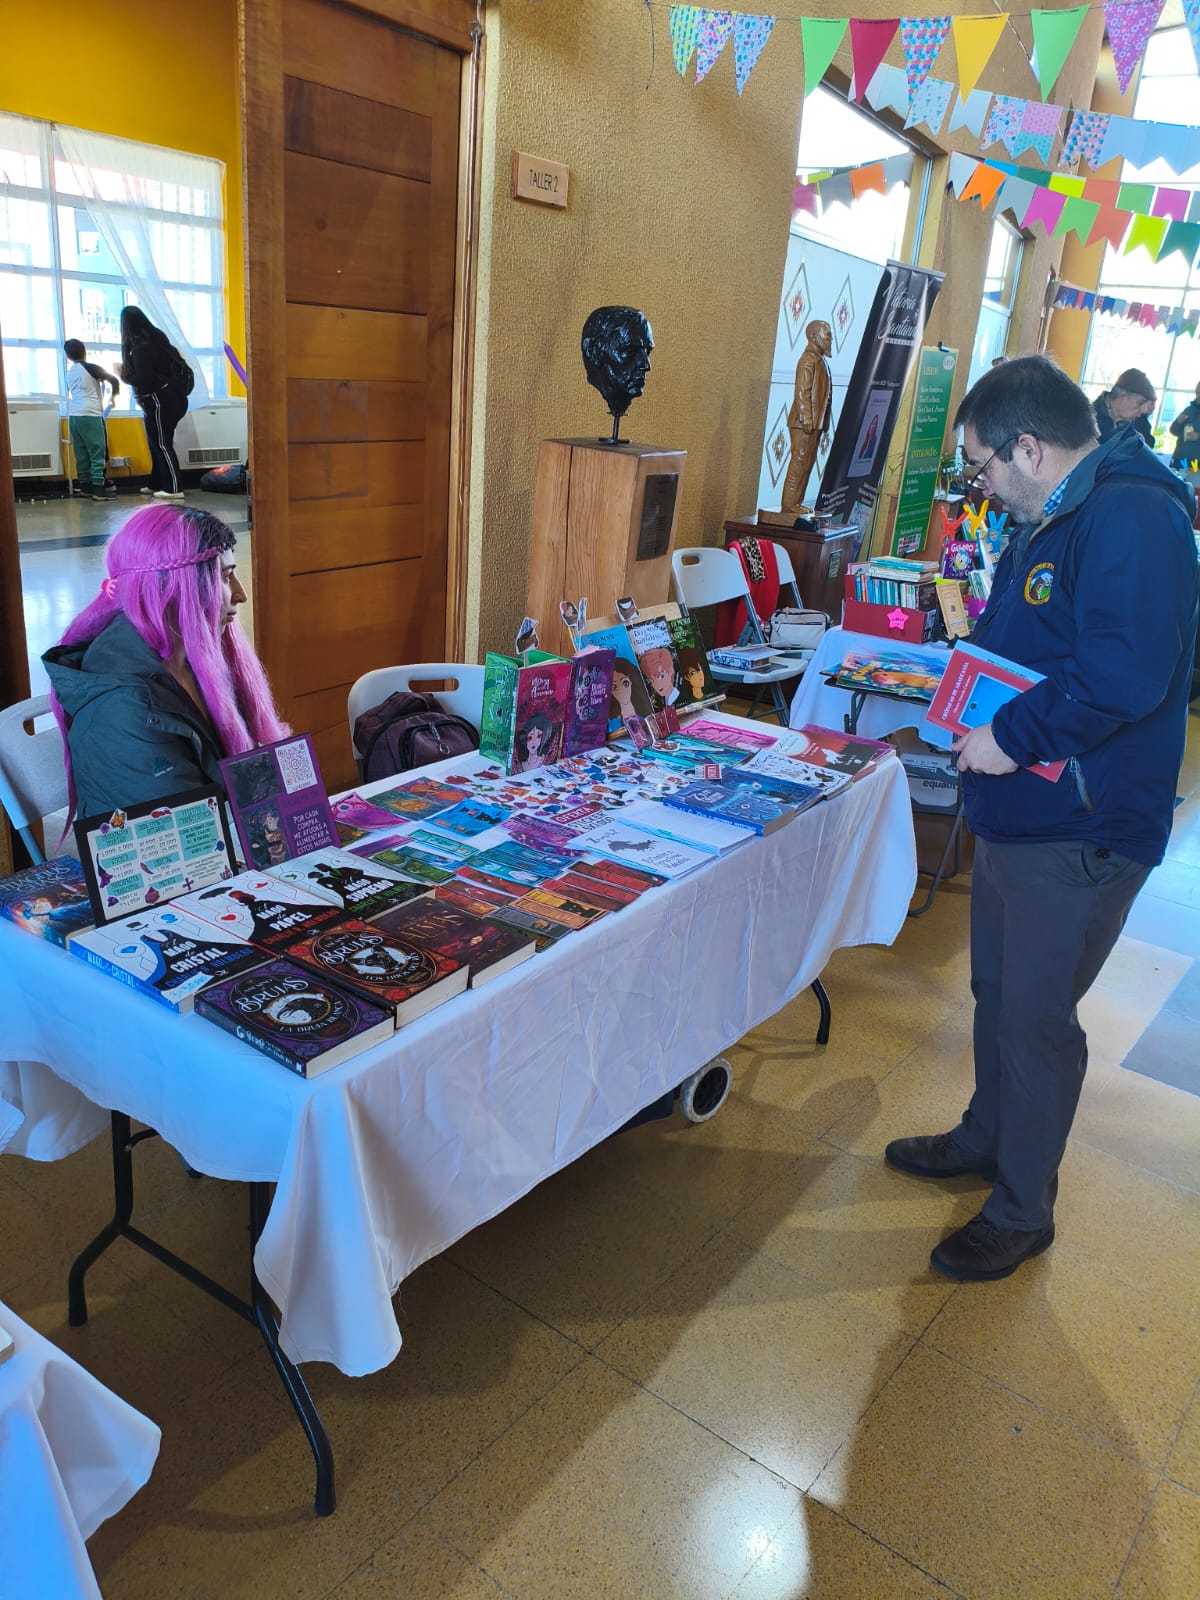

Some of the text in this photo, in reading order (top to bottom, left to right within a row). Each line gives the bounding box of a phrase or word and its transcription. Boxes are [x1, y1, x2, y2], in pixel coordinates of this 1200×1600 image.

[529, 169, 559, 193] TALLER 2
[293, 809, 319, 824] POR CADA
[555, 806, 594, 823] OFERTA
[293, 832, 301, 841] ME
[296, 833, 325, 847] ALIMENTAR
[344, 878, 372, 891] MAGO
[346, 879, 395, 902] SUPREMO
[256, 904, 287, 920] MAGO
[269, 911, 313, 931] PAPEL
[163, 940, 198, 956] MAGO
[317, 933, 384, 965] BRUJAS
[170, 947, 228, 973] CRISTAL
[236, 976, 309, 1012] BRUJAS
